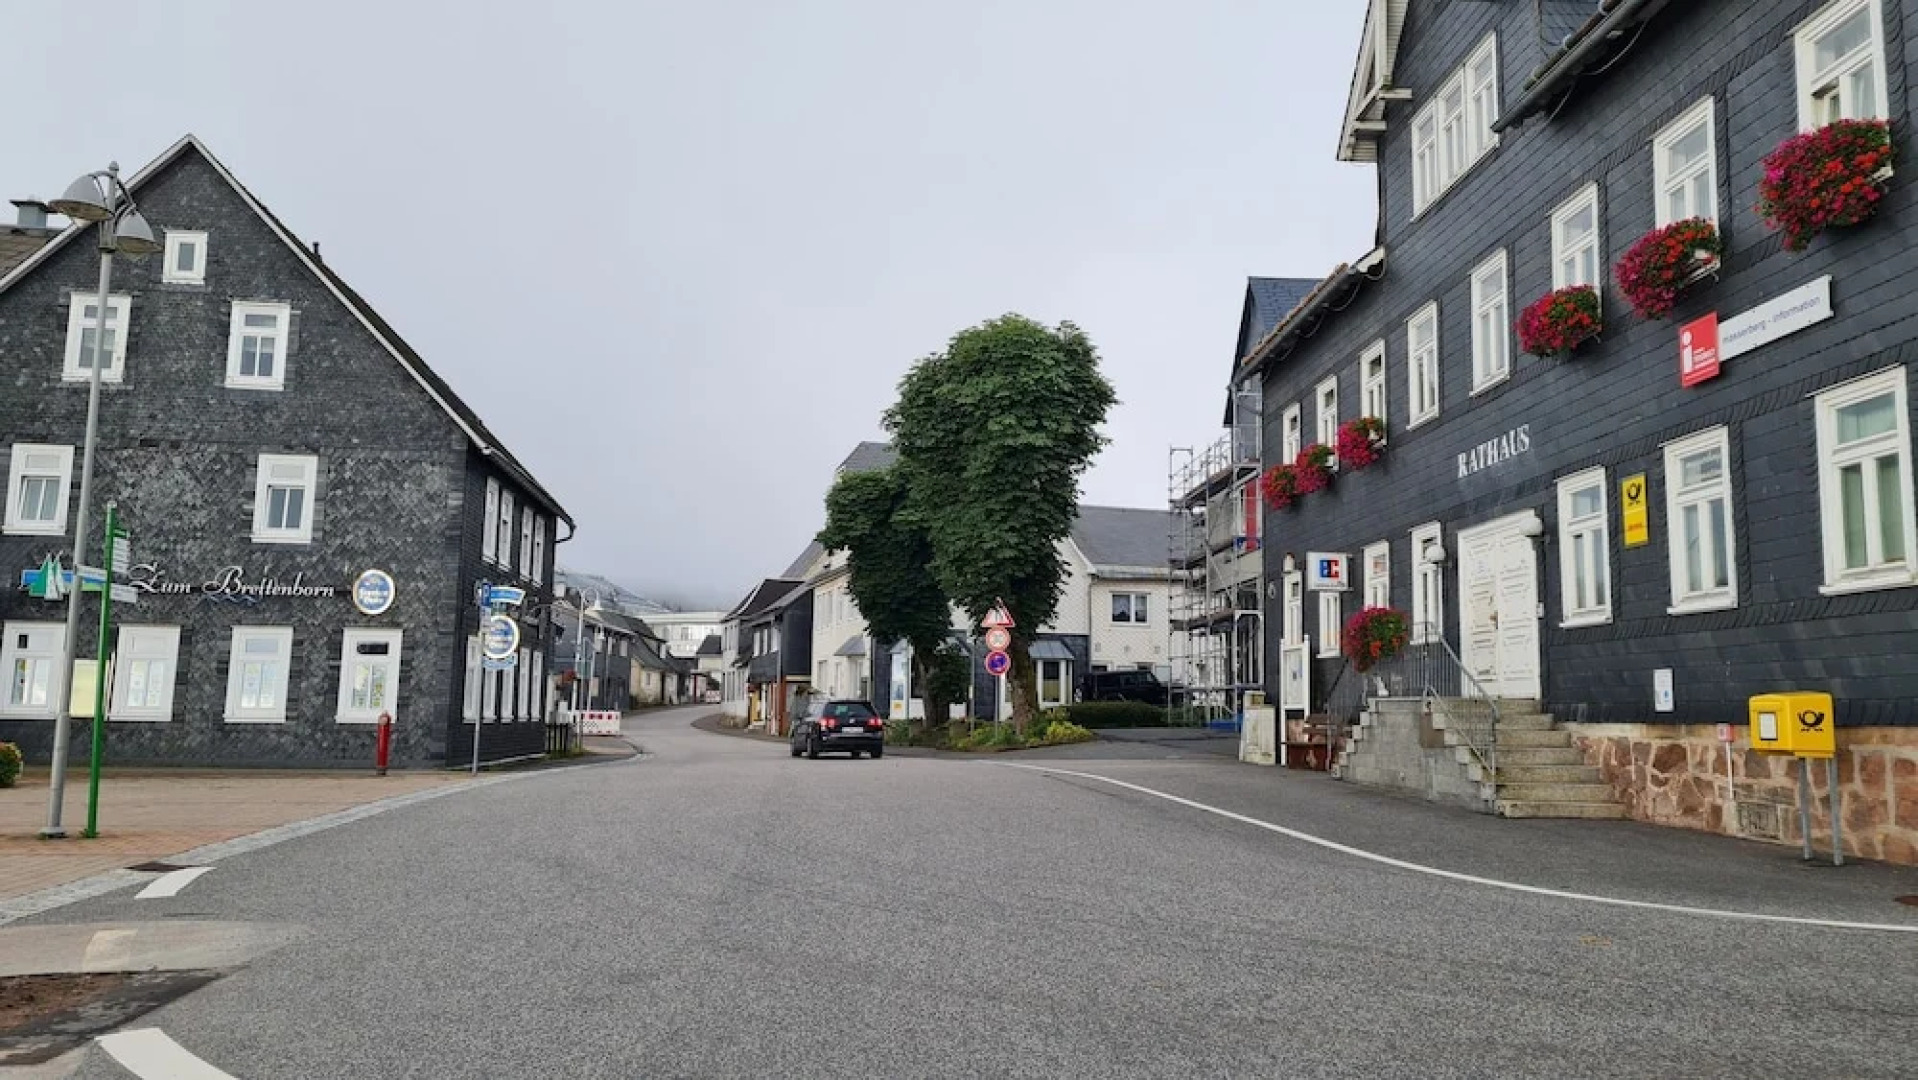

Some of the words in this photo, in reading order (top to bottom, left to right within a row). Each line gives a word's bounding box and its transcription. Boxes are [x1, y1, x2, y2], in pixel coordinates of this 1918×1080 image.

[1772, 296, 1821, 323] information
[1457, 423, 1530, 479] RATHAUS
[128, 561, 191, 594] Zum
